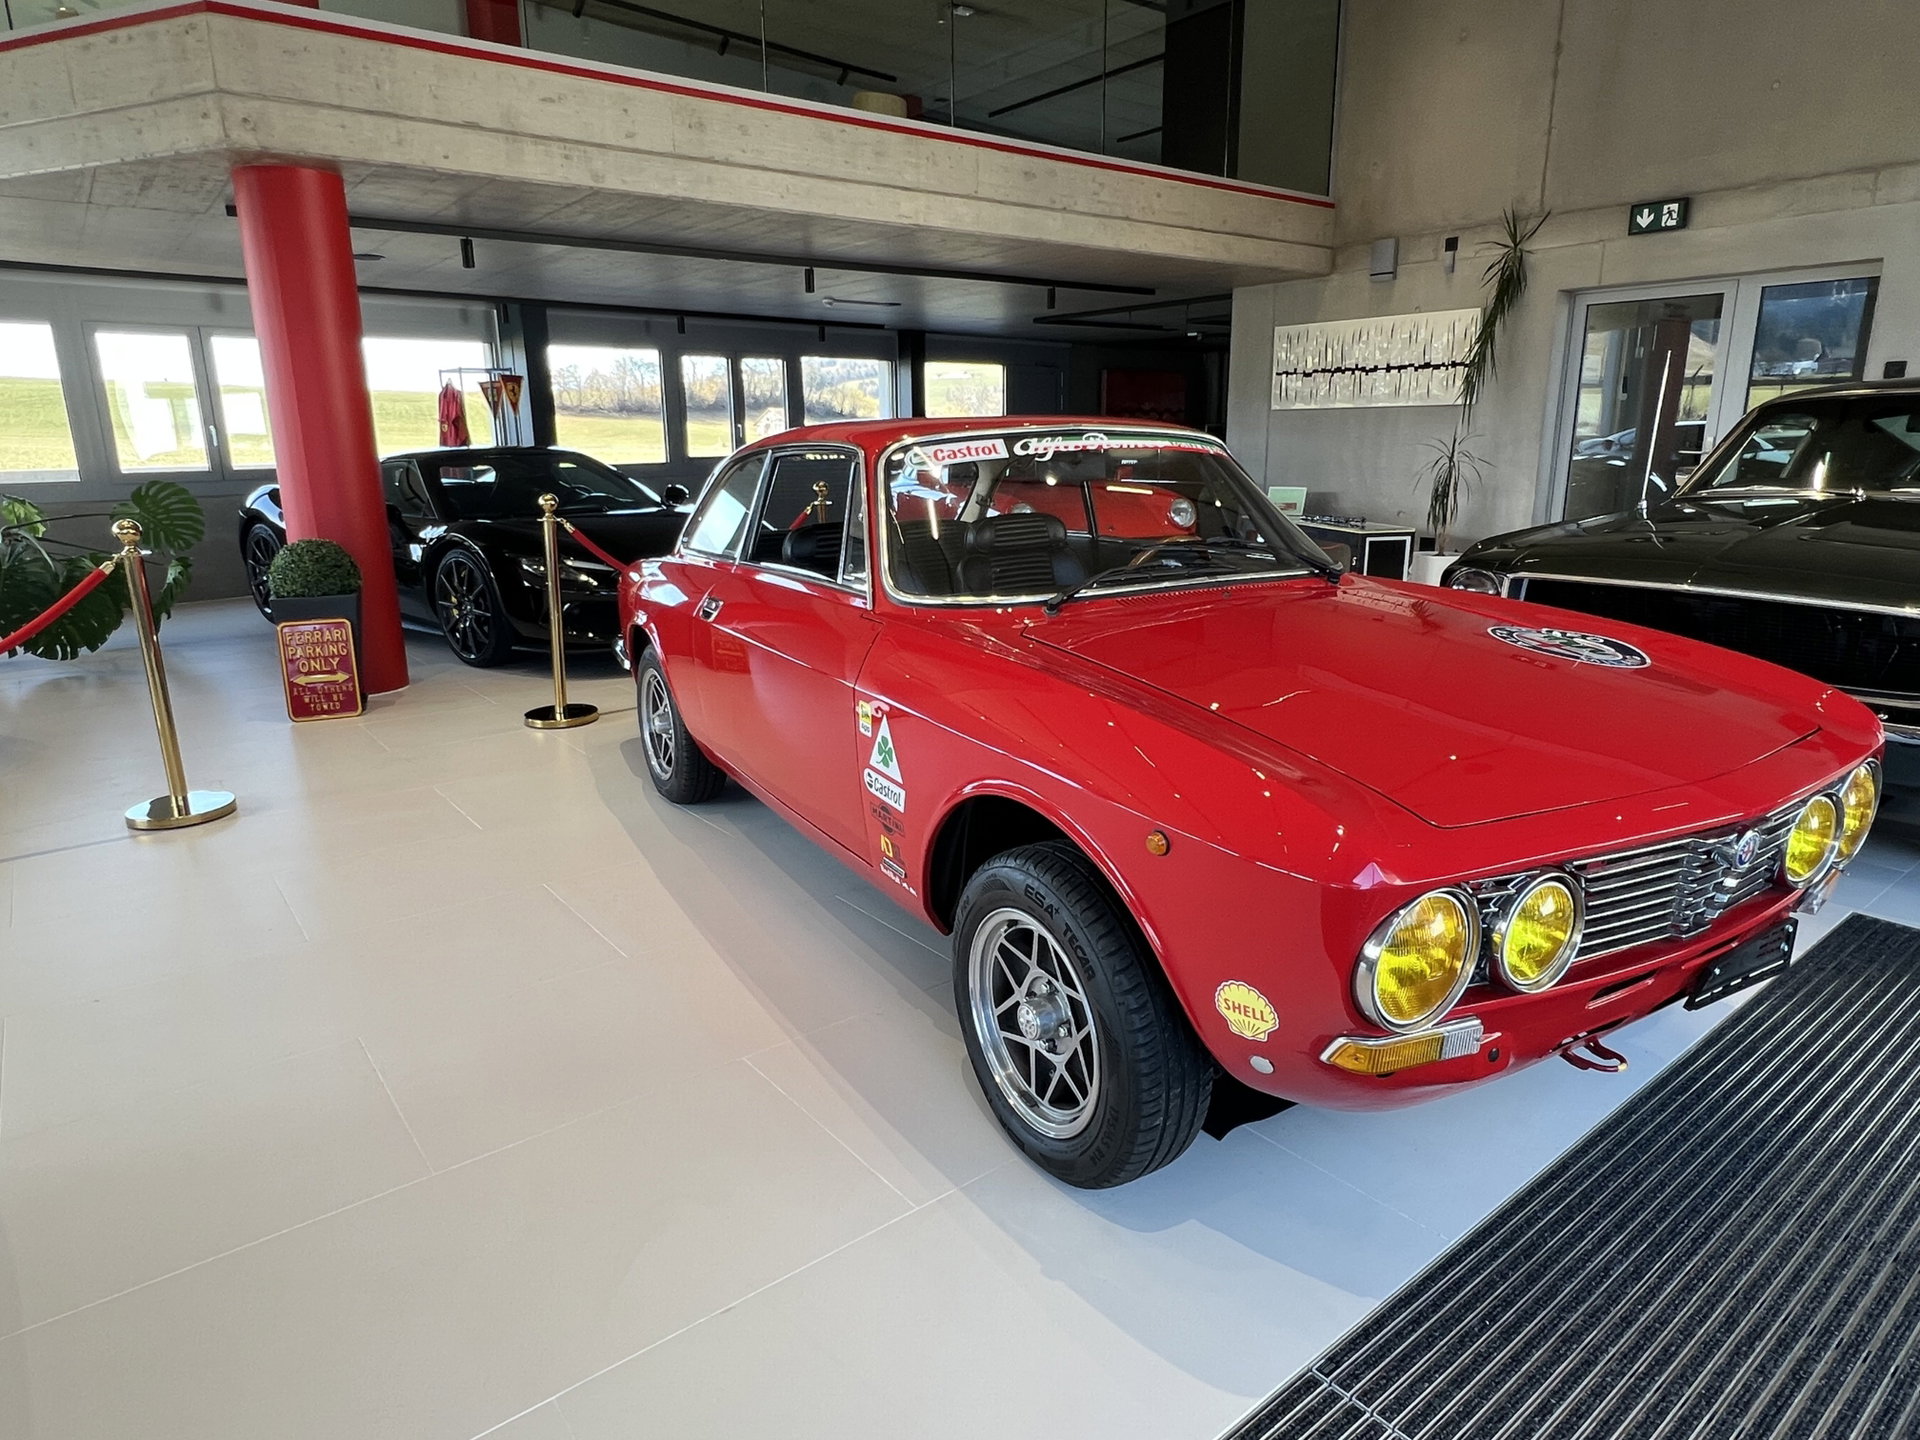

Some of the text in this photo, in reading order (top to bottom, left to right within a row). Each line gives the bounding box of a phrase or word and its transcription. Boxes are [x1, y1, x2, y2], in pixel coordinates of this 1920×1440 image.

[933, 443, 1001, 462] Castrol
[285, 628, 347, 645] FERRARI
[288, 643, 348, 660] PARKING
[299, 657, 340, 673] ONLY
[310, 701, 341, 712] TOWED
[873, 777, 903, 807] Castrol
[1062, 922, 1096, 982] TECAR
[1223, 997, 1269, 1024] SHELL
